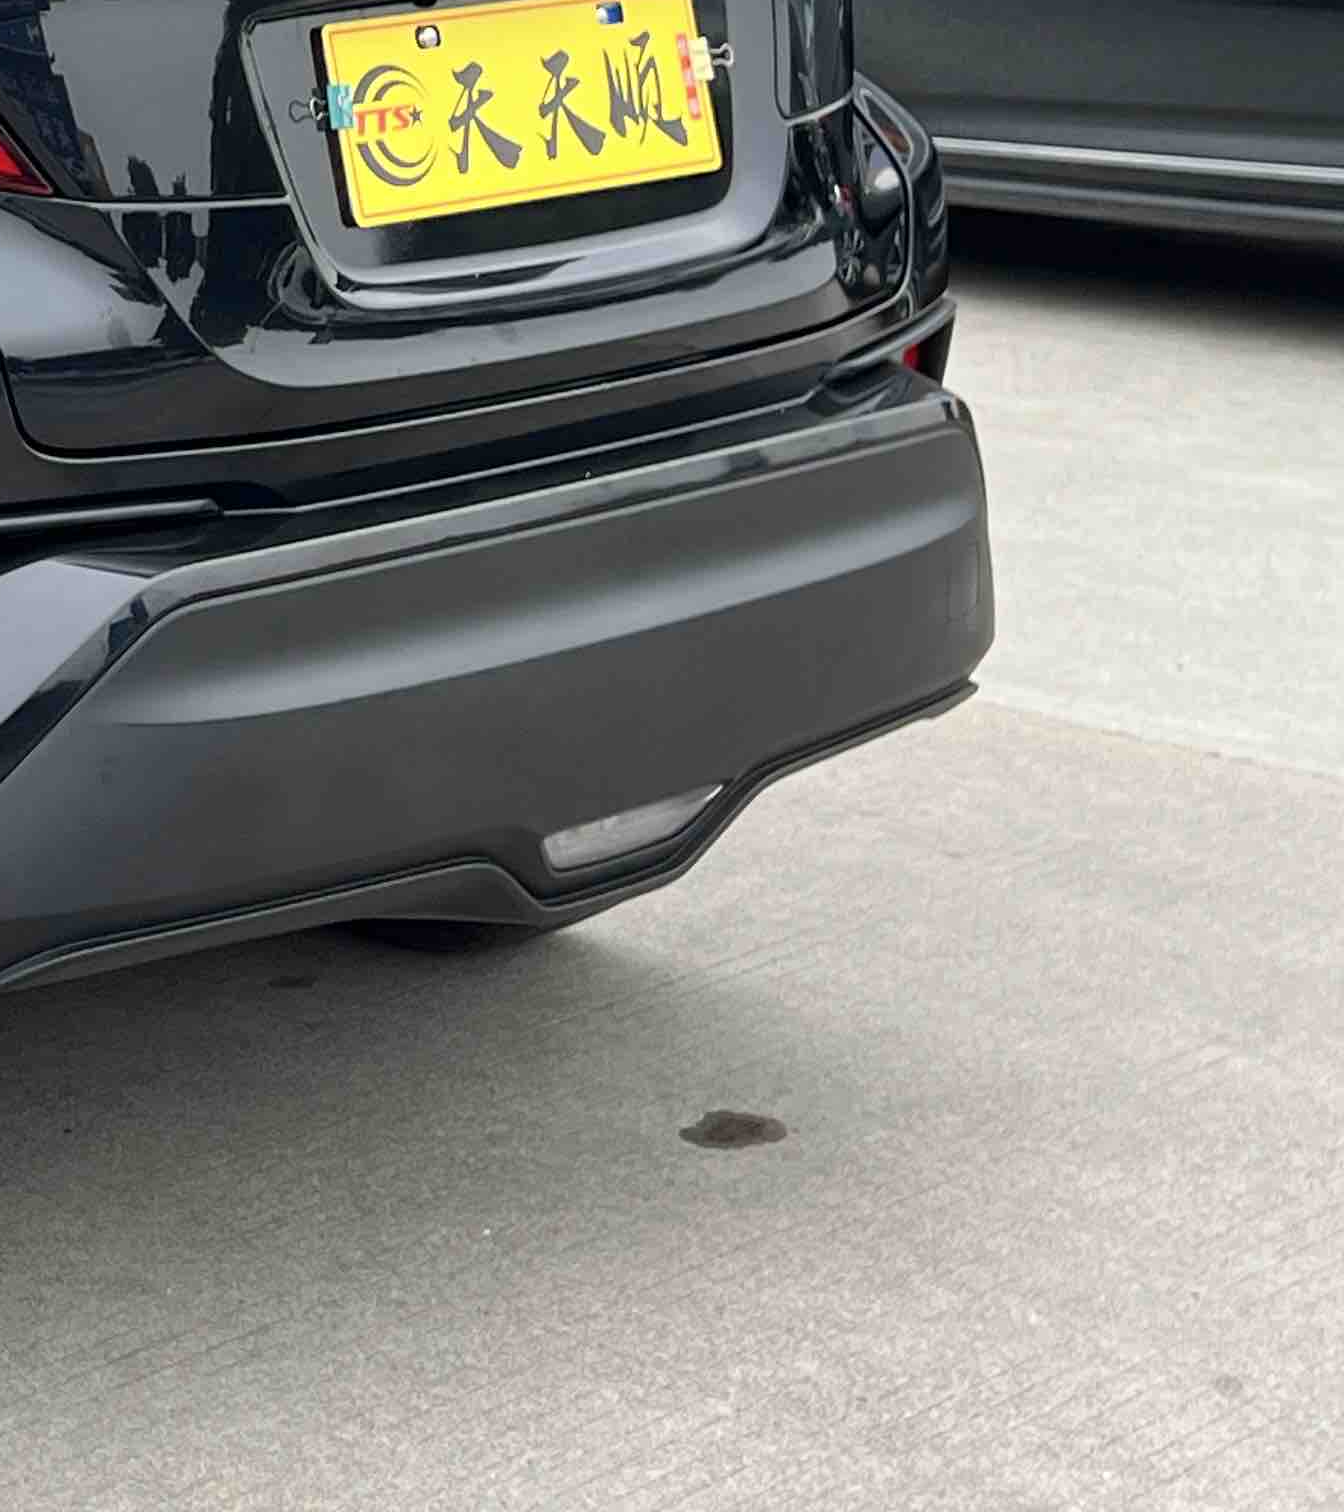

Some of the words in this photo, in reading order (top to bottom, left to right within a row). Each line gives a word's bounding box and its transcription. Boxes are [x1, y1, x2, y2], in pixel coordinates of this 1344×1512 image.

[354, 104, 412, 136] TTS
[447, 31, 689, 174] 天天顺
